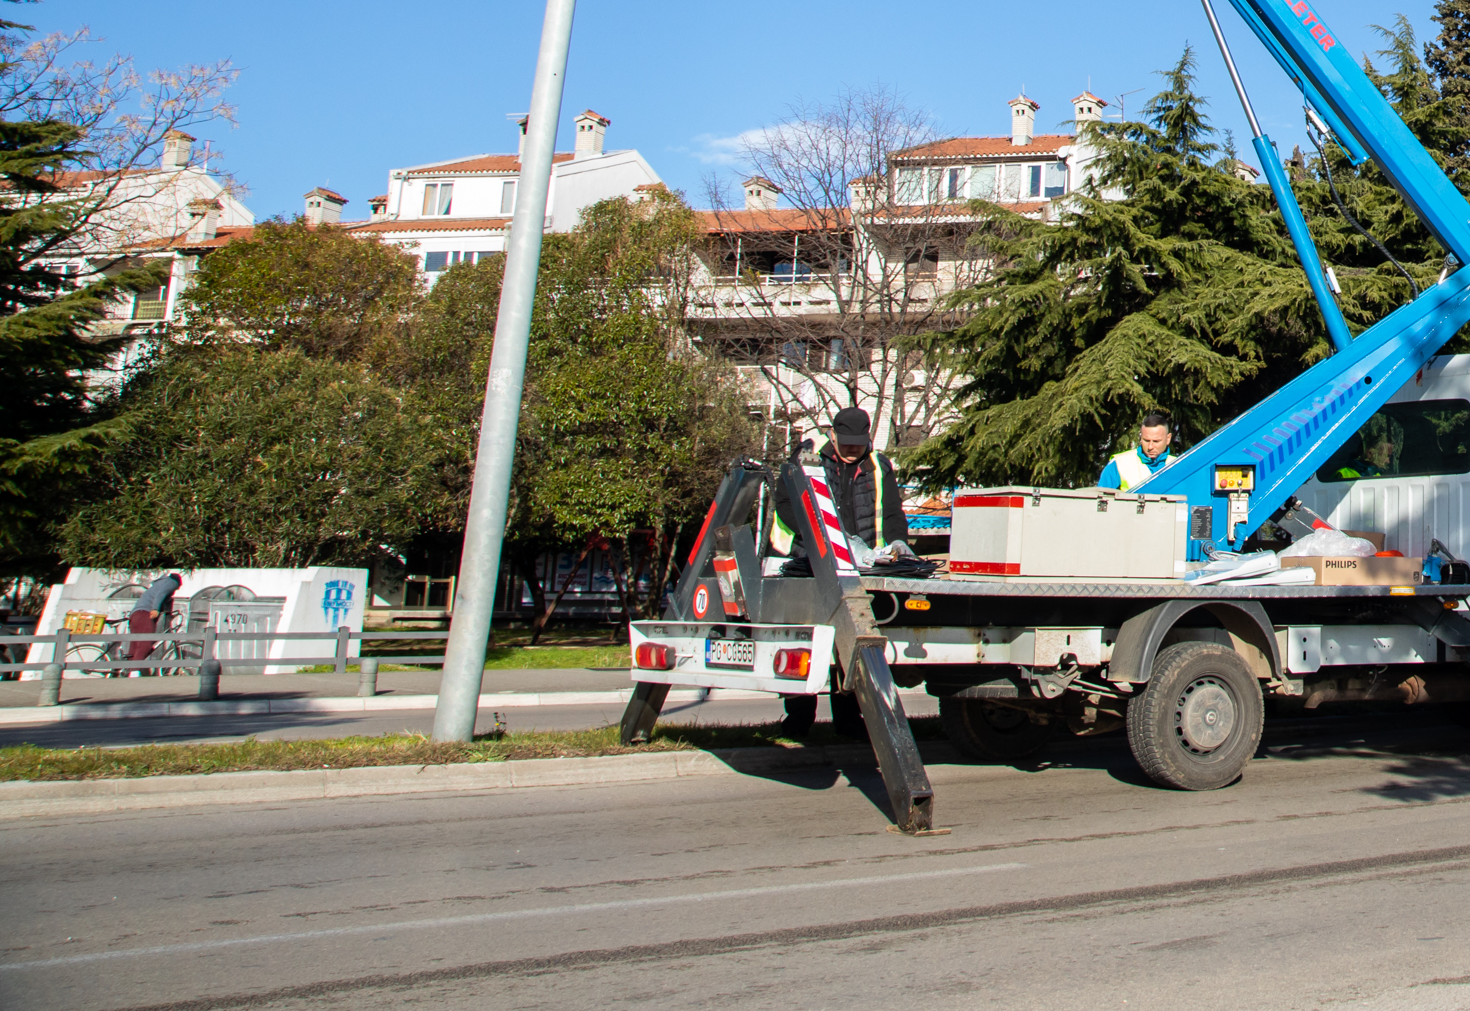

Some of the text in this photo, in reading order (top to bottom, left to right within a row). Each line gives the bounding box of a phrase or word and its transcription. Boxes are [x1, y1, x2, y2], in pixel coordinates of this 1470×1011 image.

[1325, 560, 1357, 568] PHILIPS
[698, 592, 706, 610] 70
[711, 641, 753, 663] PG CG565
